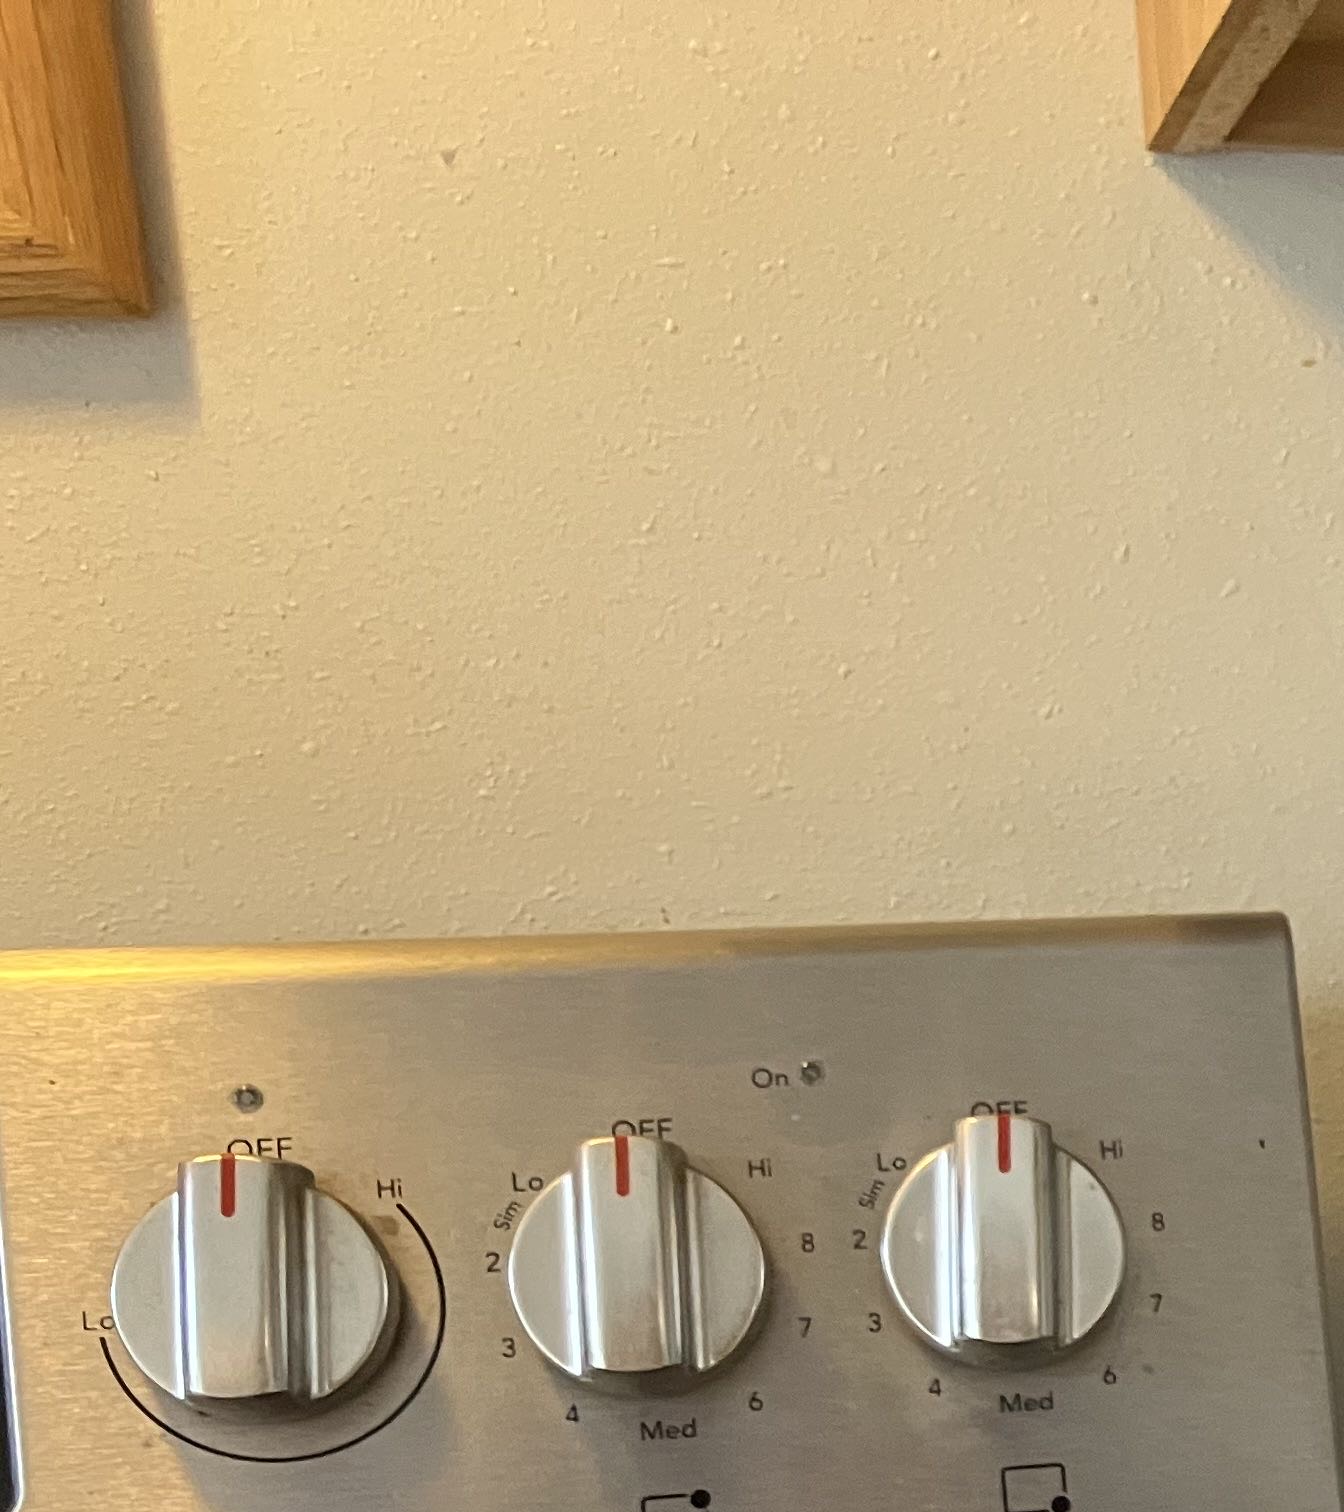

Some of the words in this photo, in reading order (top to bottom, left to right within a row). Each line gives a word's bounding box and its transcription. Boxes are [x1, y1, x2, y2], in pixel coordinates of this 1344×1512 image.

[751, 1067, 790, 1090] On
[970, 1100, 1029, 1117] OFF
[611, 1117, 673, 1139] OFF
[227, 1136, 292, 1159] OFF
[1100, 1139, 1124, 1160] Hi
[747, 1158, 773, 1178] Hi
[876, 1153, 907, 1172] Lo
[376, 1178, 403, 1199] Hi
[511, 1171, 544, 1192] Lo
[494, 1200, 525, 1231] Sim
[1150, 1212, 1166, 1233] 8
[800, 1232, 815, 1253] 8
[852, 1229, 868, 1250] 2
[485, 1252, 501, 1273] 2
[1149, 1293, 1163, 1314] 7
[82, 1311, 115, 1331] Lo
[798, 1317, 812, 1339] 7
[867, 1313, 882, 1333] 3
[501, 1338, 517, 1358] 3
[1103, 1365, 1117, 1386] 6
[928, 1378, 942, 1397] 4
[748, 1392, 764, 1412] 6
[999, 1391, 1054, 1413] Med
[565, 1404, 580, 1424] 4
[640, 1419, 698, 1441] Med
